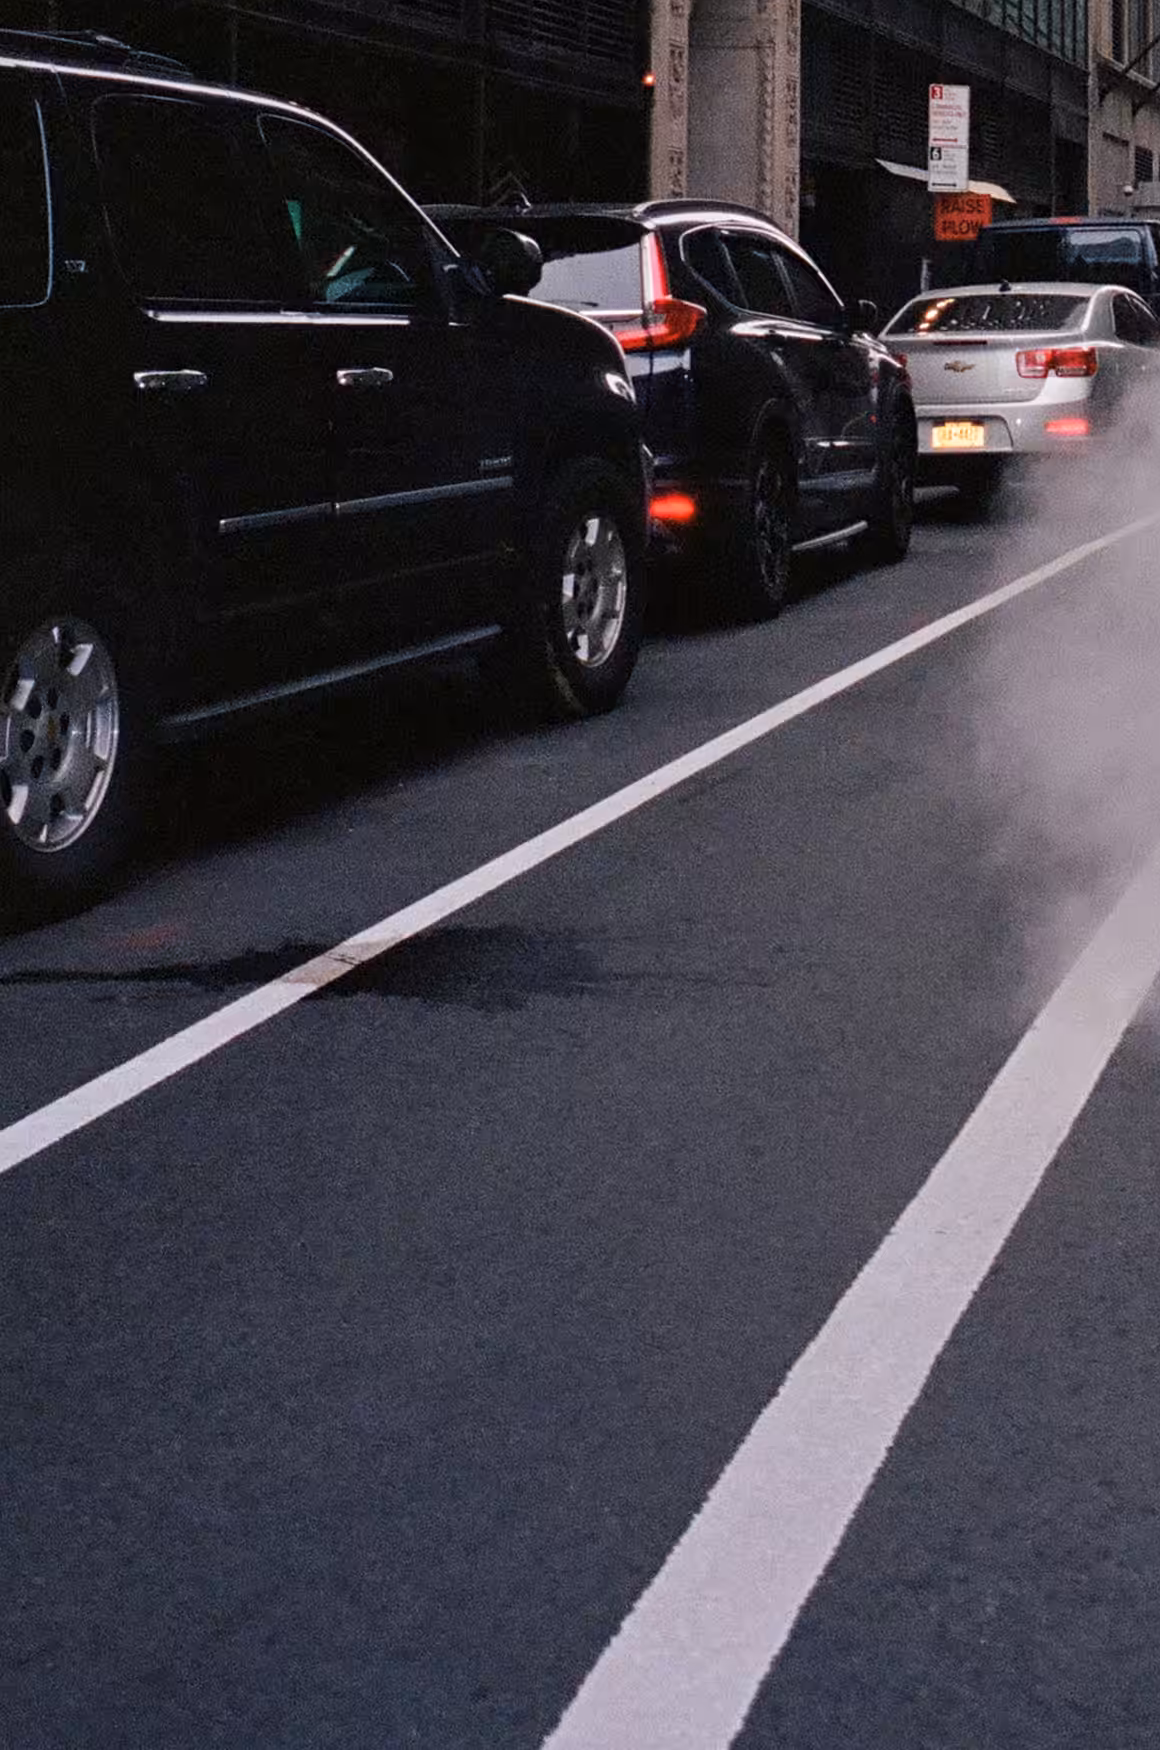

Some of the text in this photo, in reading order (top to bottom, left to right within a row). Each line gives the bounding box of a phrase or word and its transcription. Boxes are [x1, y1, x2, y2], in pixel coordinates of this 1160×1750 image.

[933, 86, 941, 98] 3
[932, 148, 940, 160] 6
[940, 198, 985, 214] RAISE
